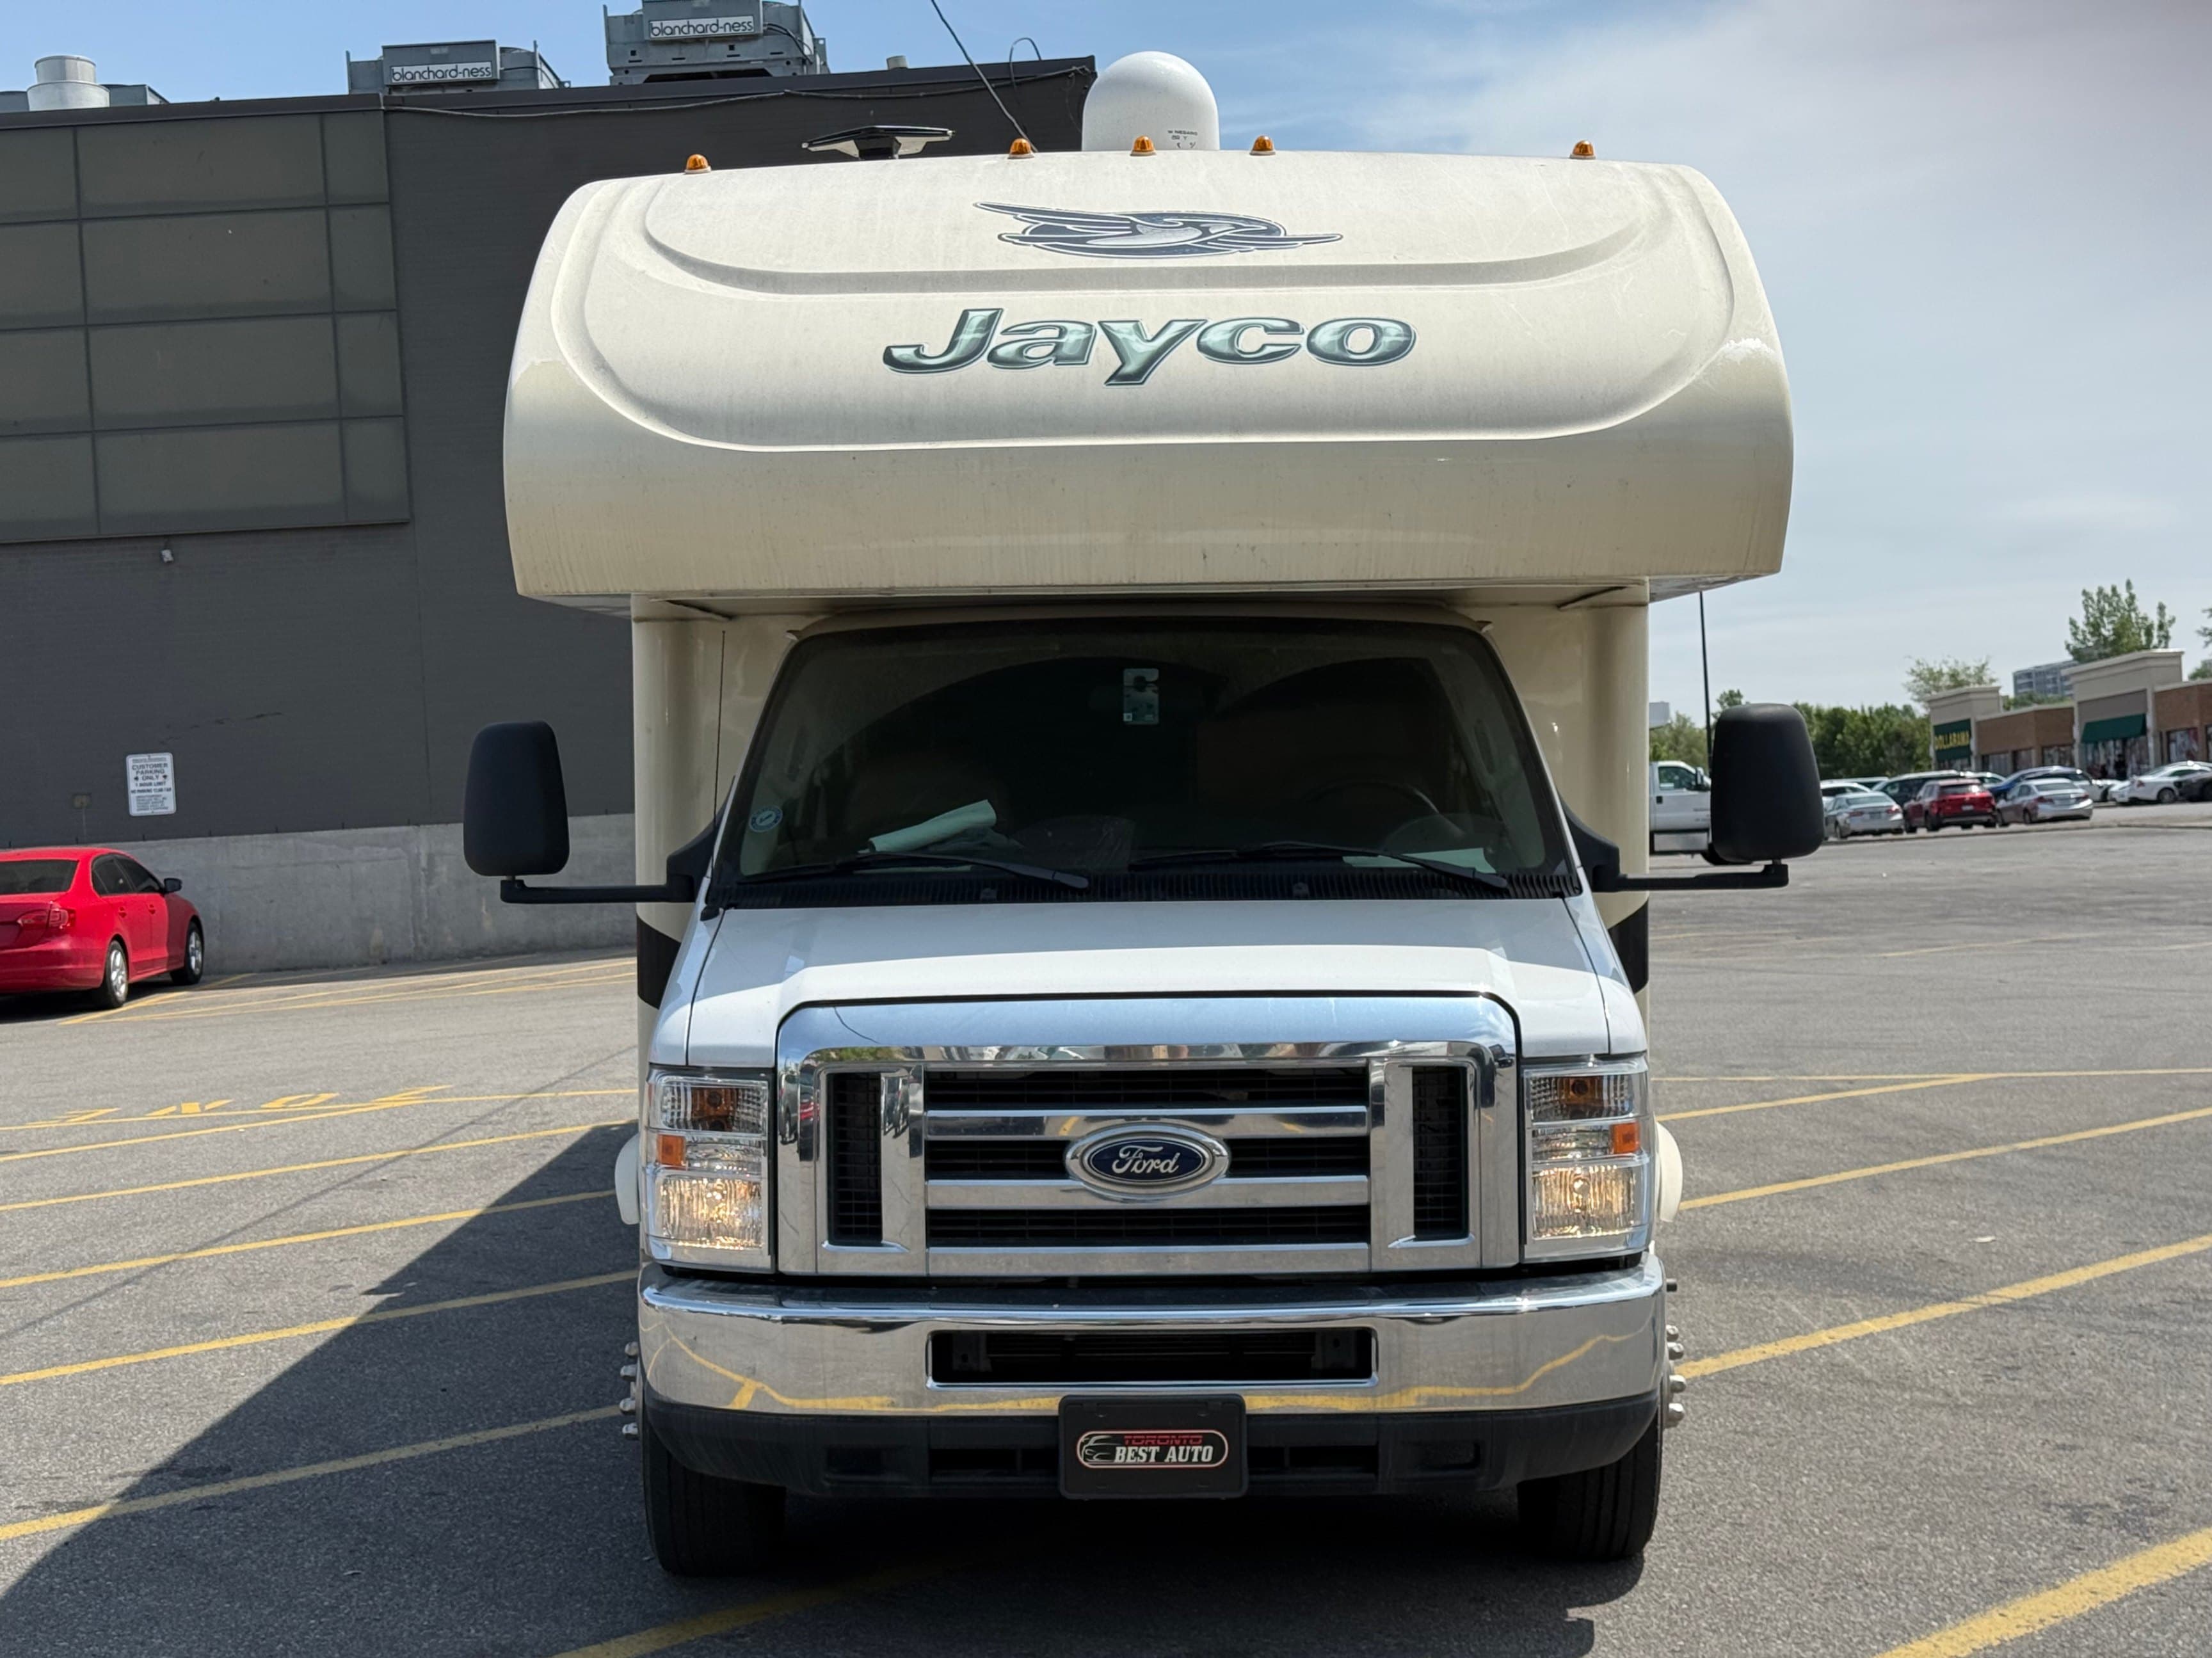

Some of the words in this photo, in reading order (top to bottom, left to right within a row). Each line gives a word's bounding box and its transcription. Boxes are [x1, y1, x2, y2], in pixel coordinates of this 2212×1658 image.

[650, 19, 753, 36] blanchard-ness
[392, 65, 492, 82] blanchard-ness
[883, 307, 1418, 387] Jayco
[1112, 1145, 1180, 1174] Ford
[1124, 1435, 1204, 1446] TORONTO
[1114, 1446, 1160, 1463] BEST
[1164, 1445, 1214, 1462] AUTO
